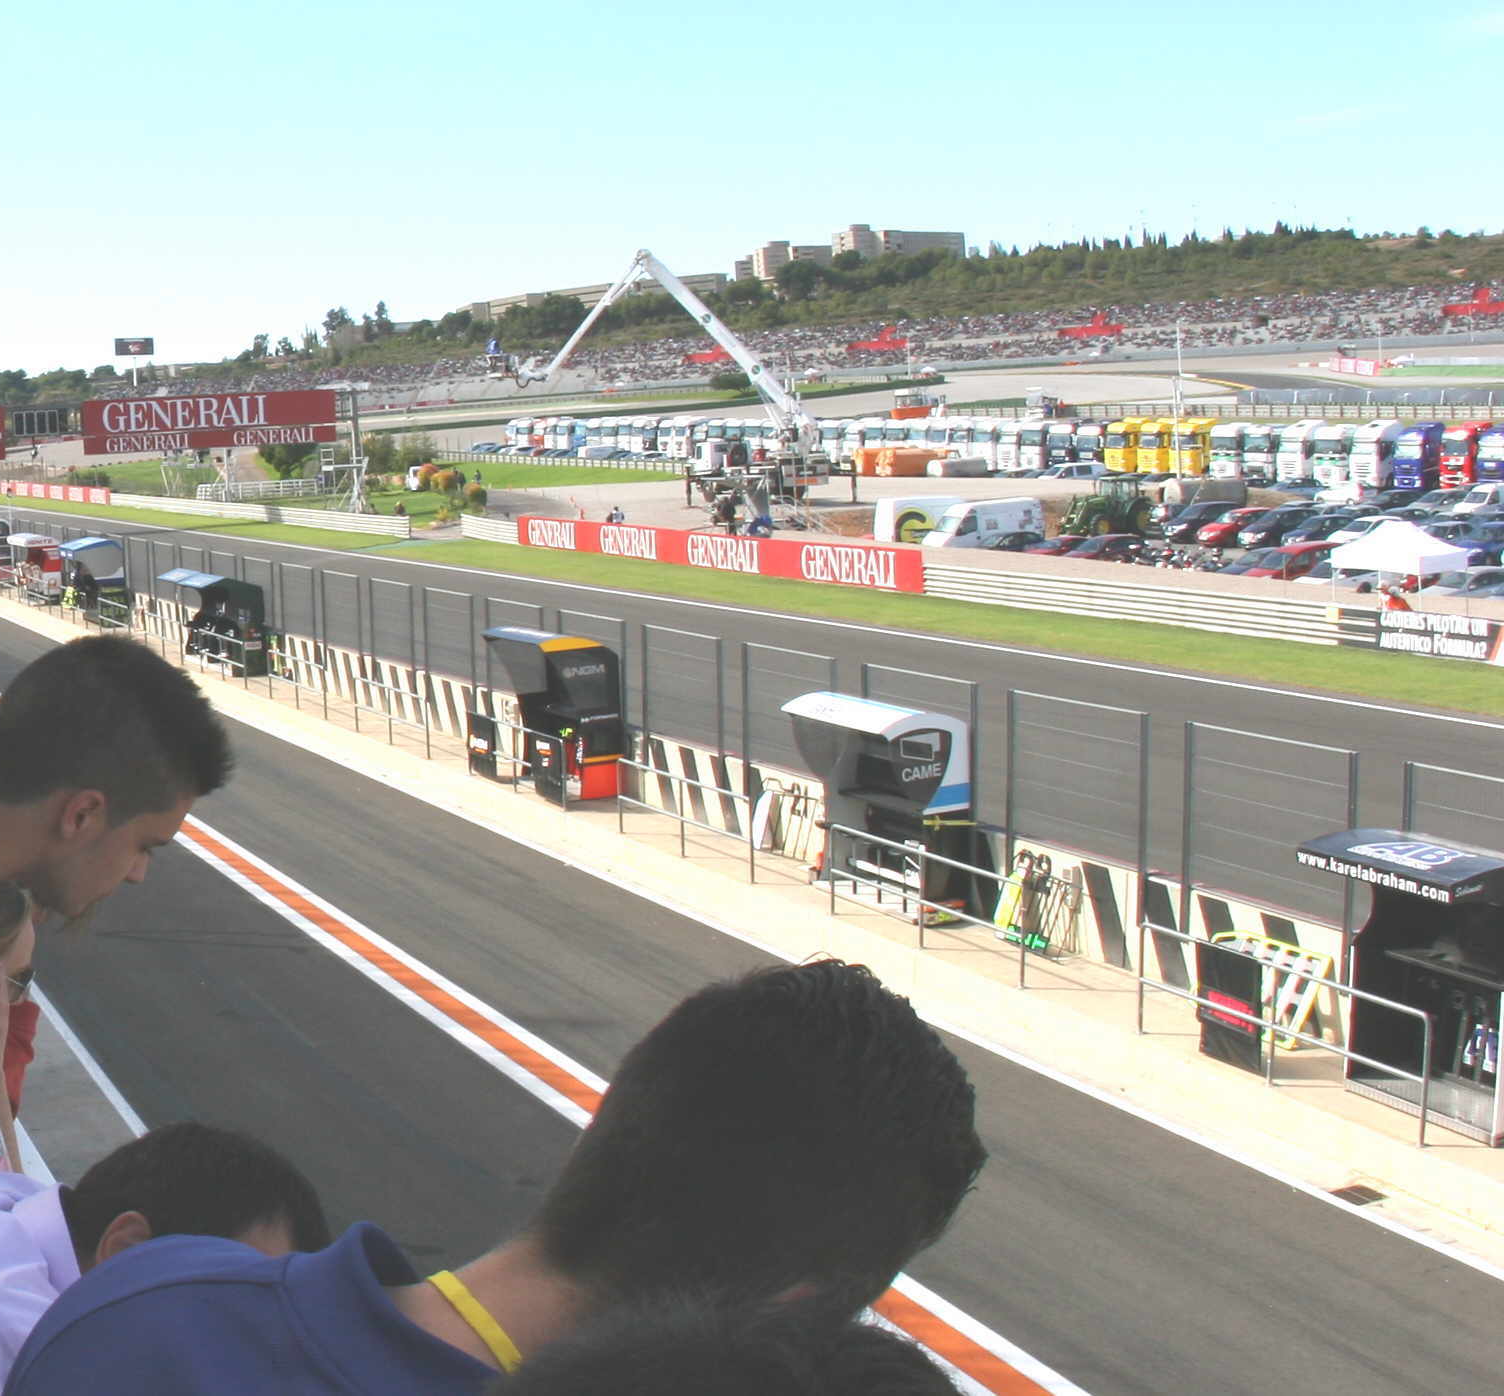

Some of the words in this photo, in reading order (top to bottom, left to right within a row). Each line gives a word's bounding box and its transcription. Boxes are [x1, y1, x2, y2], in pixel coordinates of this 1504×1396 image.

[102, 394, 269, 433] GENERALI
[106, 433, 190, 453] GENERALI
[233, 428, 314, 445] GENERALI
[527, 519, 576, 550] GENERALI
[599, 525, 657, 560] GENERALI
[687, 534, 760, 574] GENERALI
[801, 544, 897, 588] GENERALI
[901, 763, 943, 782] CAME
[1296, 850, 1450, 903] www.karelabraham.com
